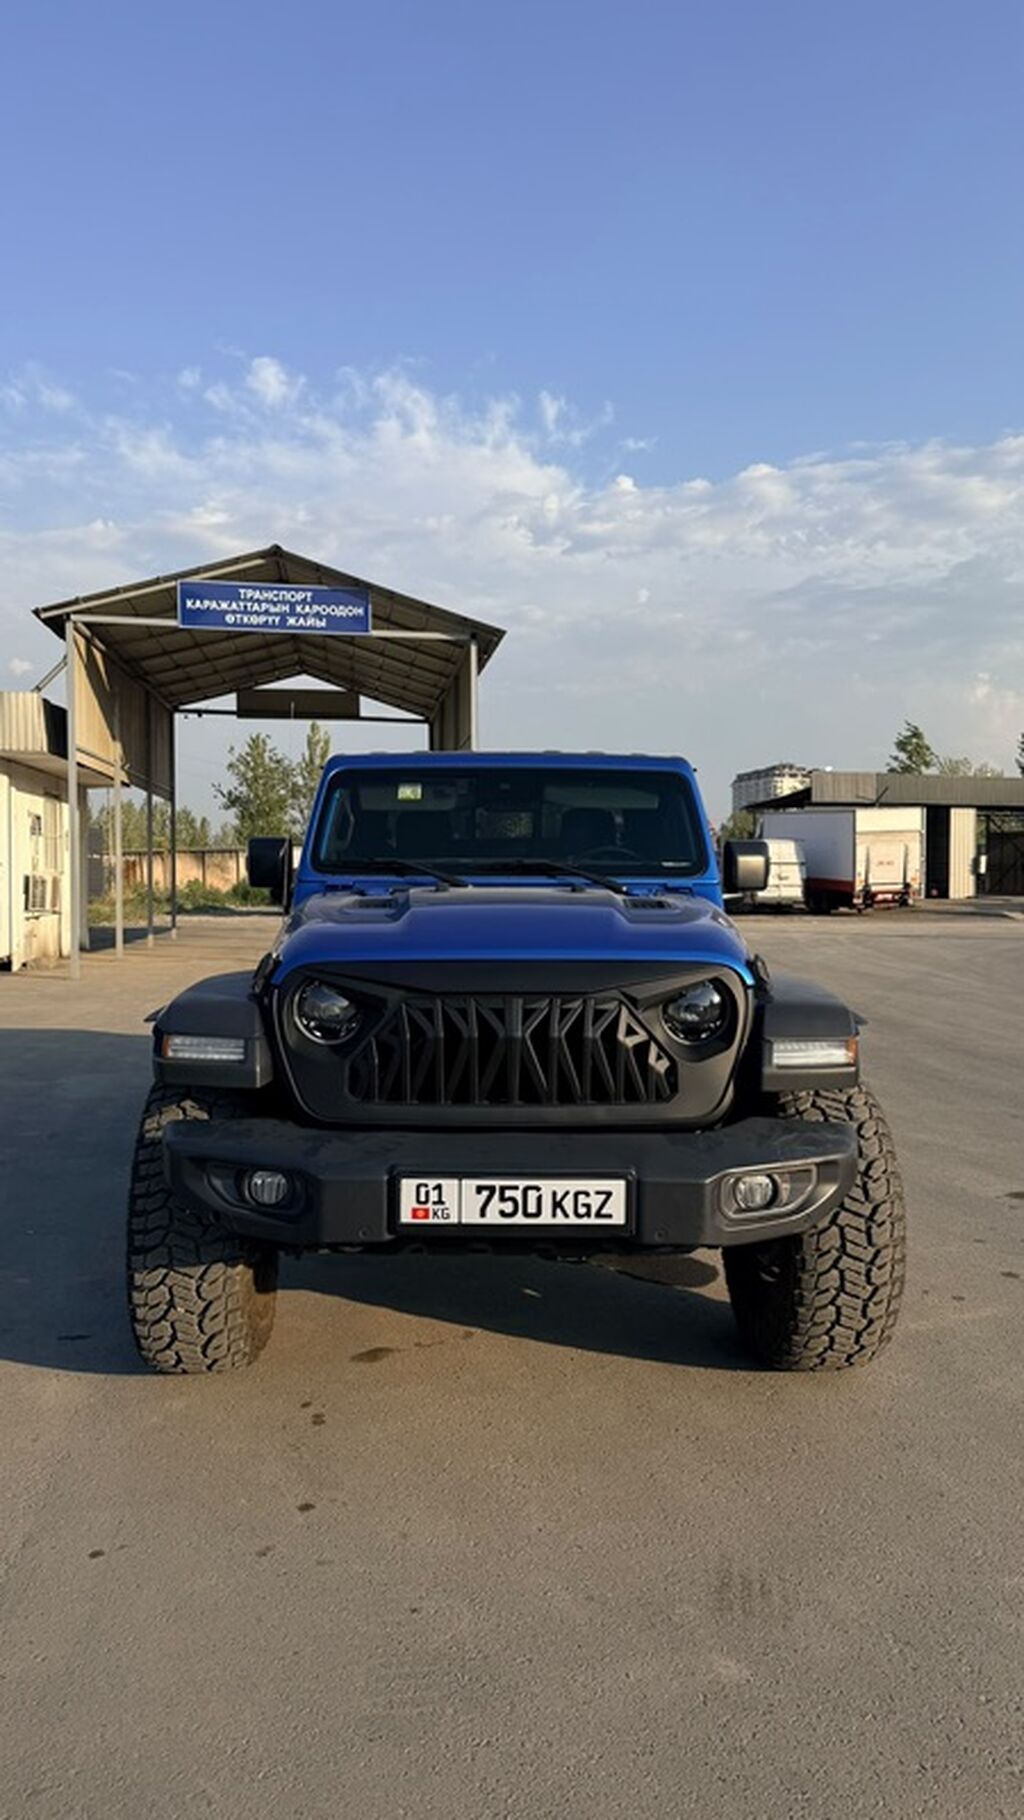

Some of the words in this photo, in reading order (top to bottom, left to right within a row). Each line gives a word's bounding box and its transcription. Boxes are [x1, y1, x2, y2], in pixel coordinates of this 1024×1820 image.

[238, 588, 313, 602] ТРАНСПОРТ
[186, 599, 290, 613] КАРАЖАТТАРЫН
[295, 603, 364, 616] КАРООДОН
[286, 614, 327, 628] ЖАЙЫ
[415, 1182, 446, 1206] 01
[475, 1184, 543, 1219] 750
[551, 1190, 613, 1219] KGZ
[432, 1207, 450, 1220] KG
